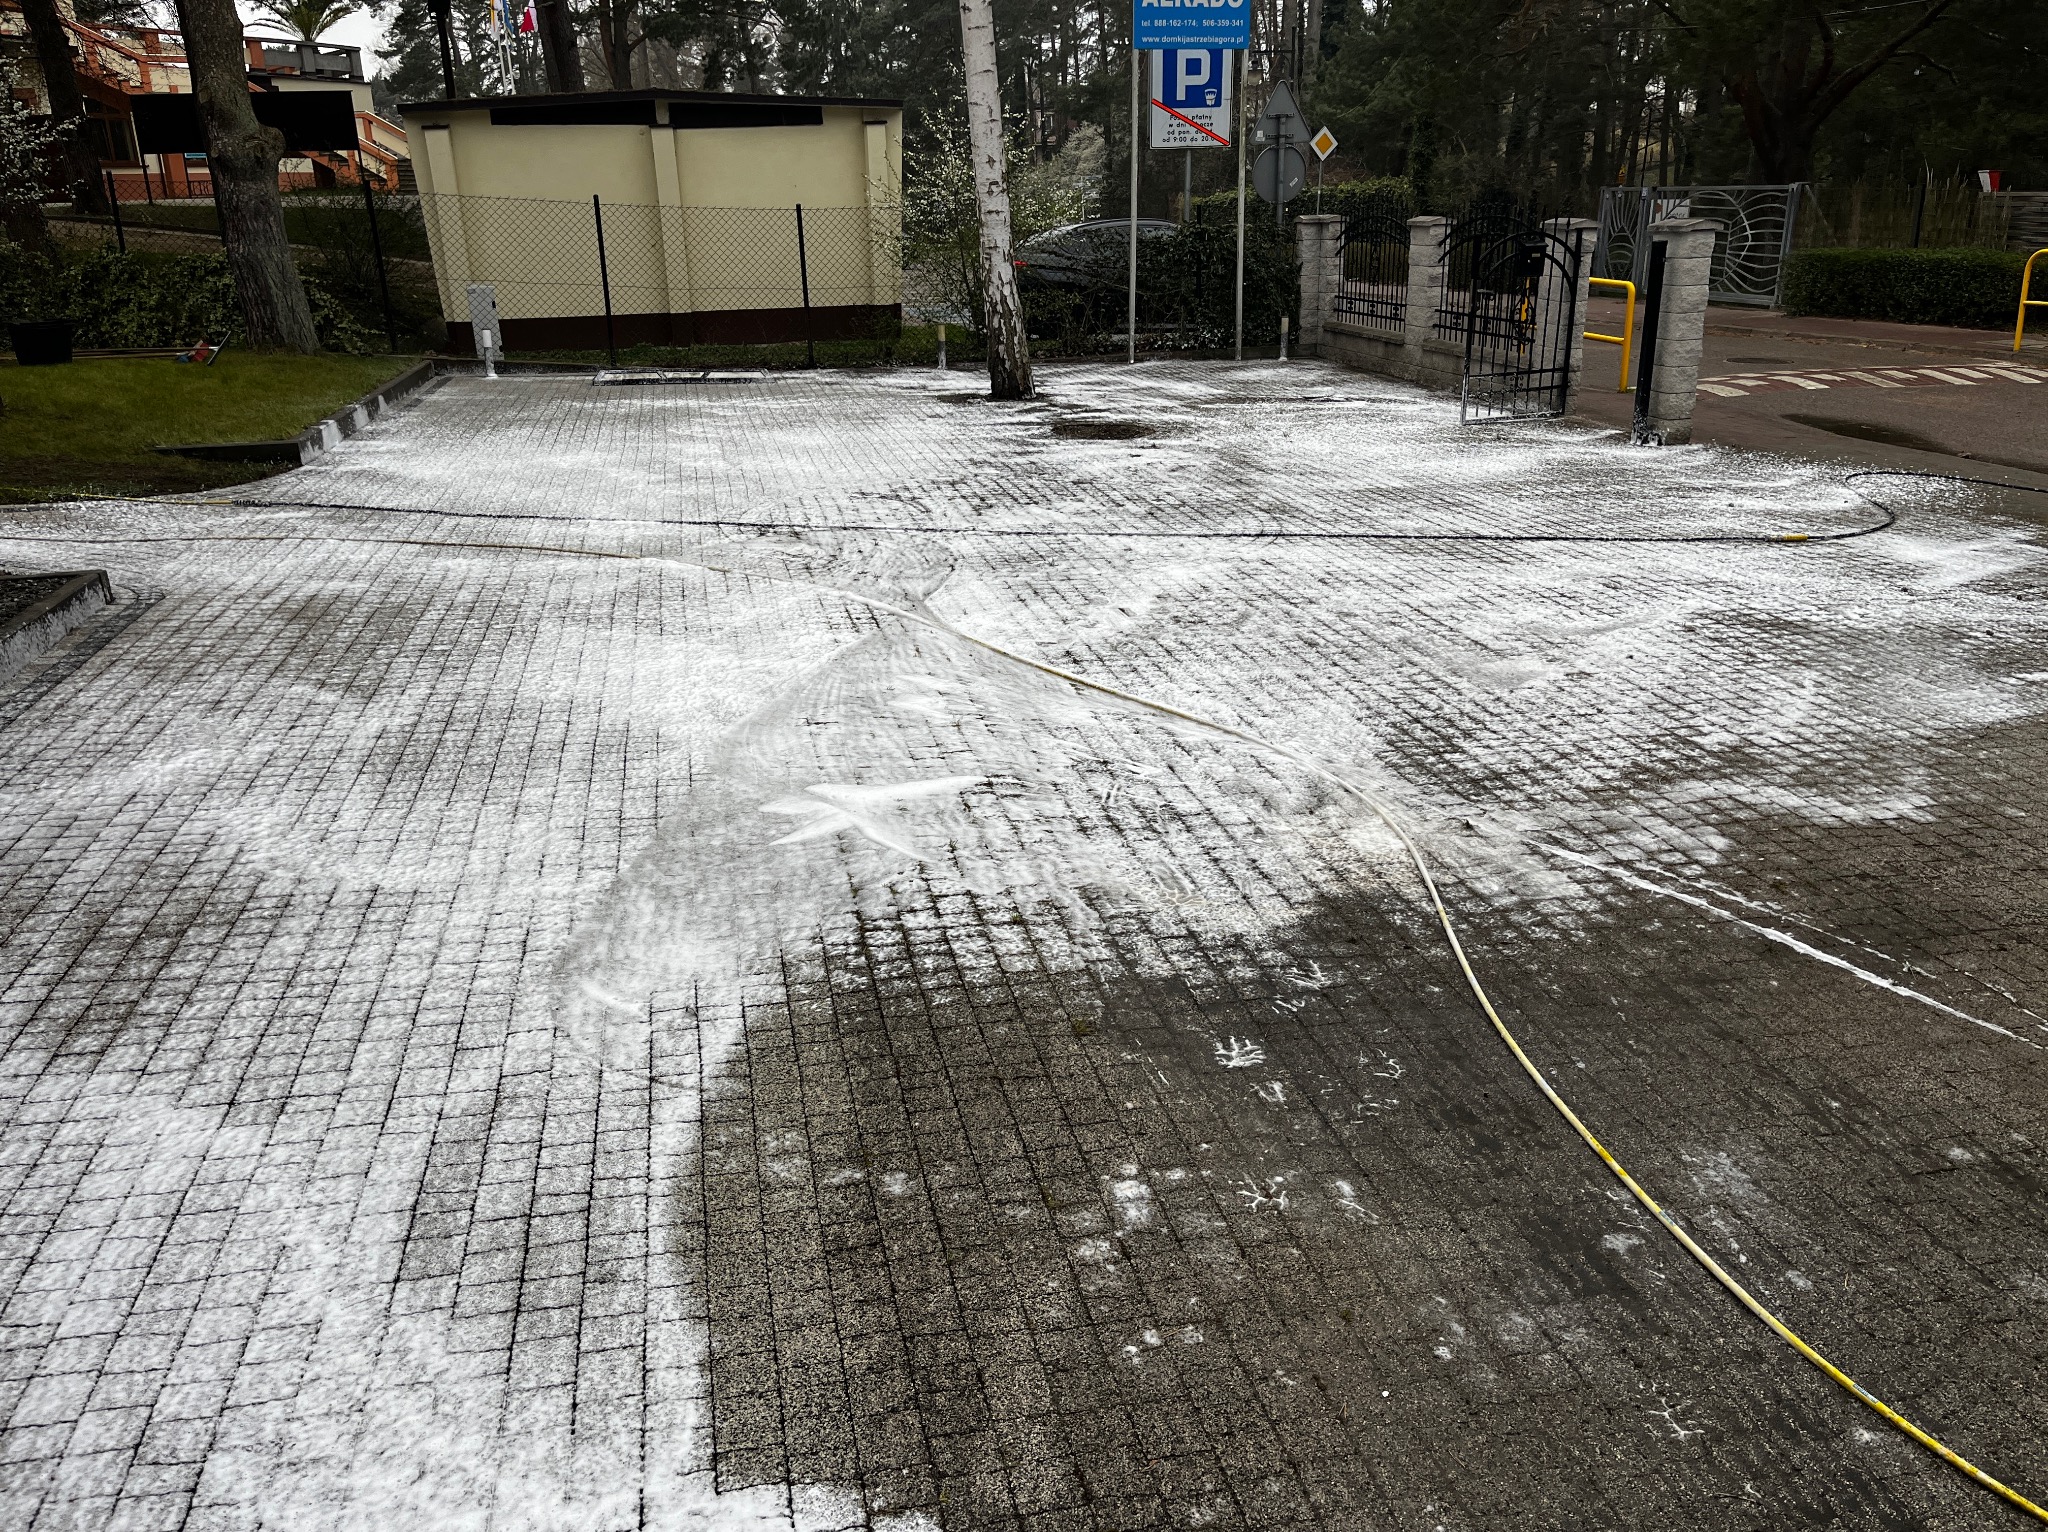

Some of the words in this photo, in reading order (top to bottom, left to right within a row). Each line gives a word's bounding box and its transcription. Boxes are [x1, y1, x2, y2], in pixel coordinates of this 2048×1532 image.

[1202, 19, 1244, 27] 506-359-341
[1141, 35, 1244, 45] www.domkijastrzebiagora.pl
[1176, 49, 1211, 101] P
